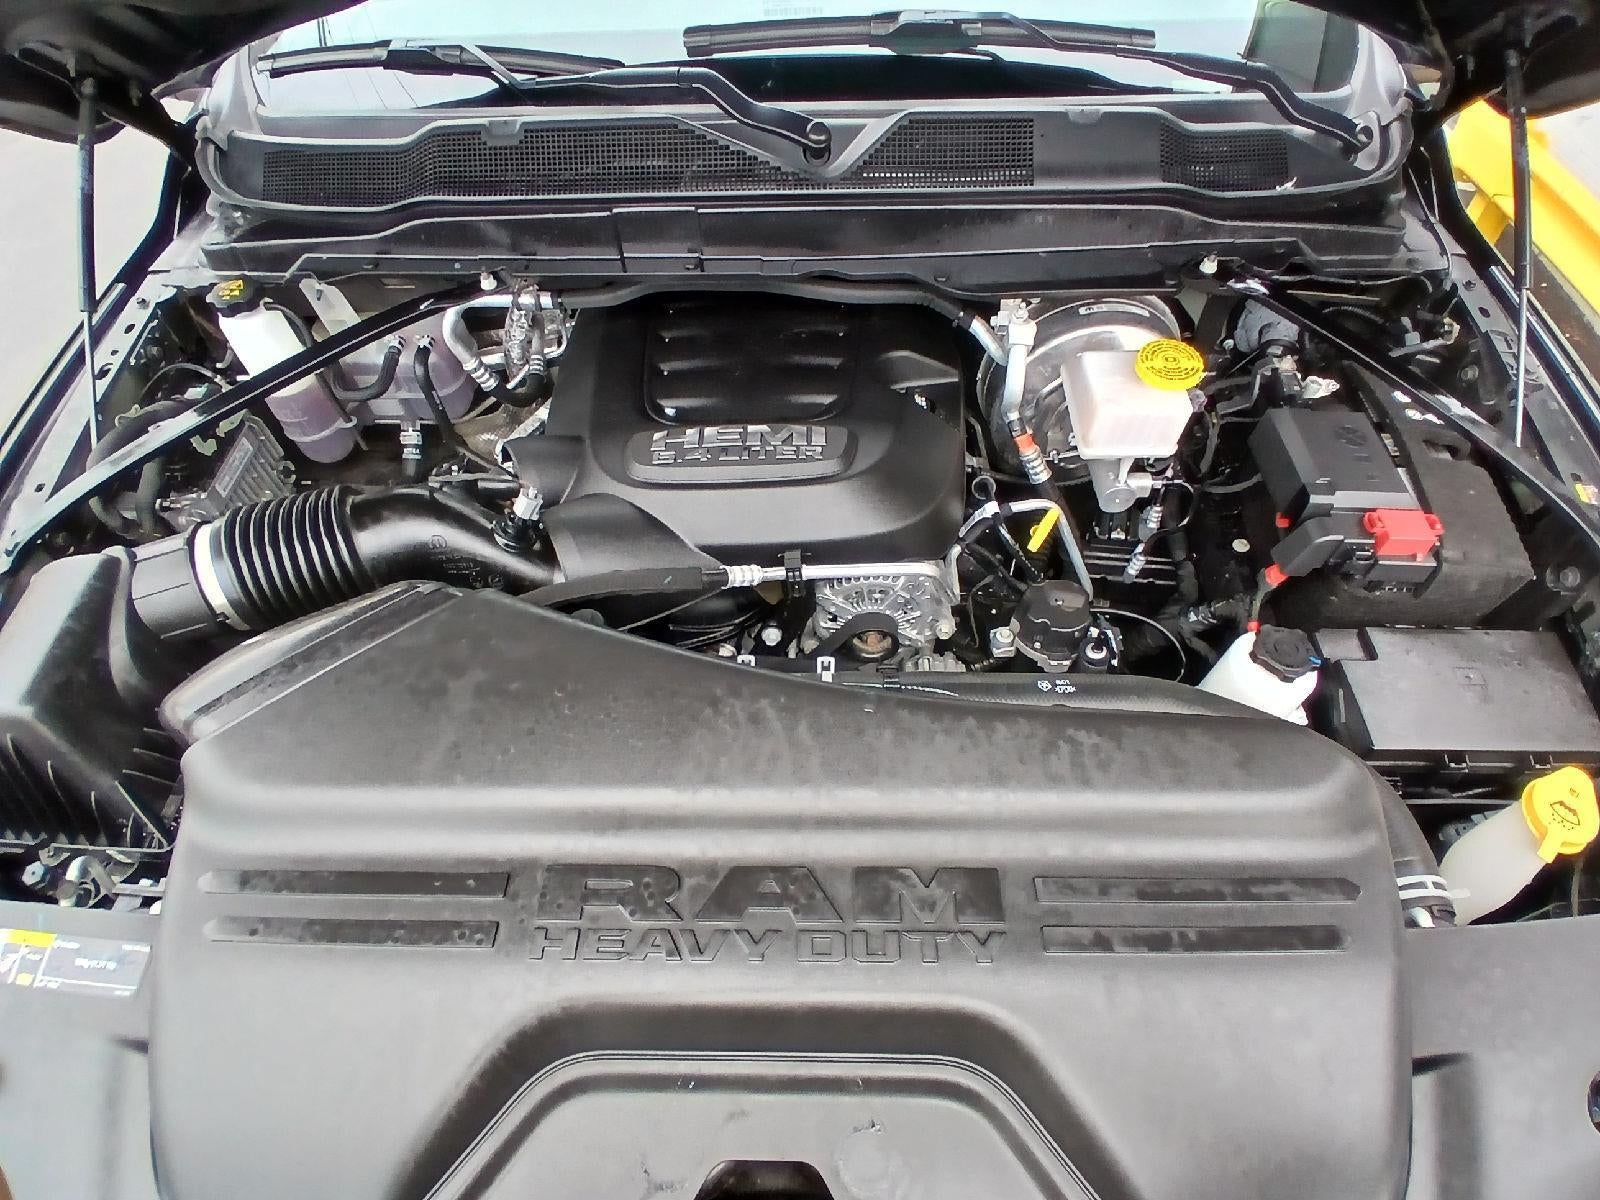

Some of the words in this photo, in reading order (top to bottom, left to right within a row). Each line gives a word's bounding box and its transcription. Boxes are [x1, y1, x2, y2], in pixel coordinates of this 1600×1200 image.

[651, 424, 827, 450] HEMI
[718, 446, 823, 462] LITER
[536, 864, 1006, 924] RAM
[528, 926, 784, 962] HEAVY
[797, 929, 1006, 964] DUTY
